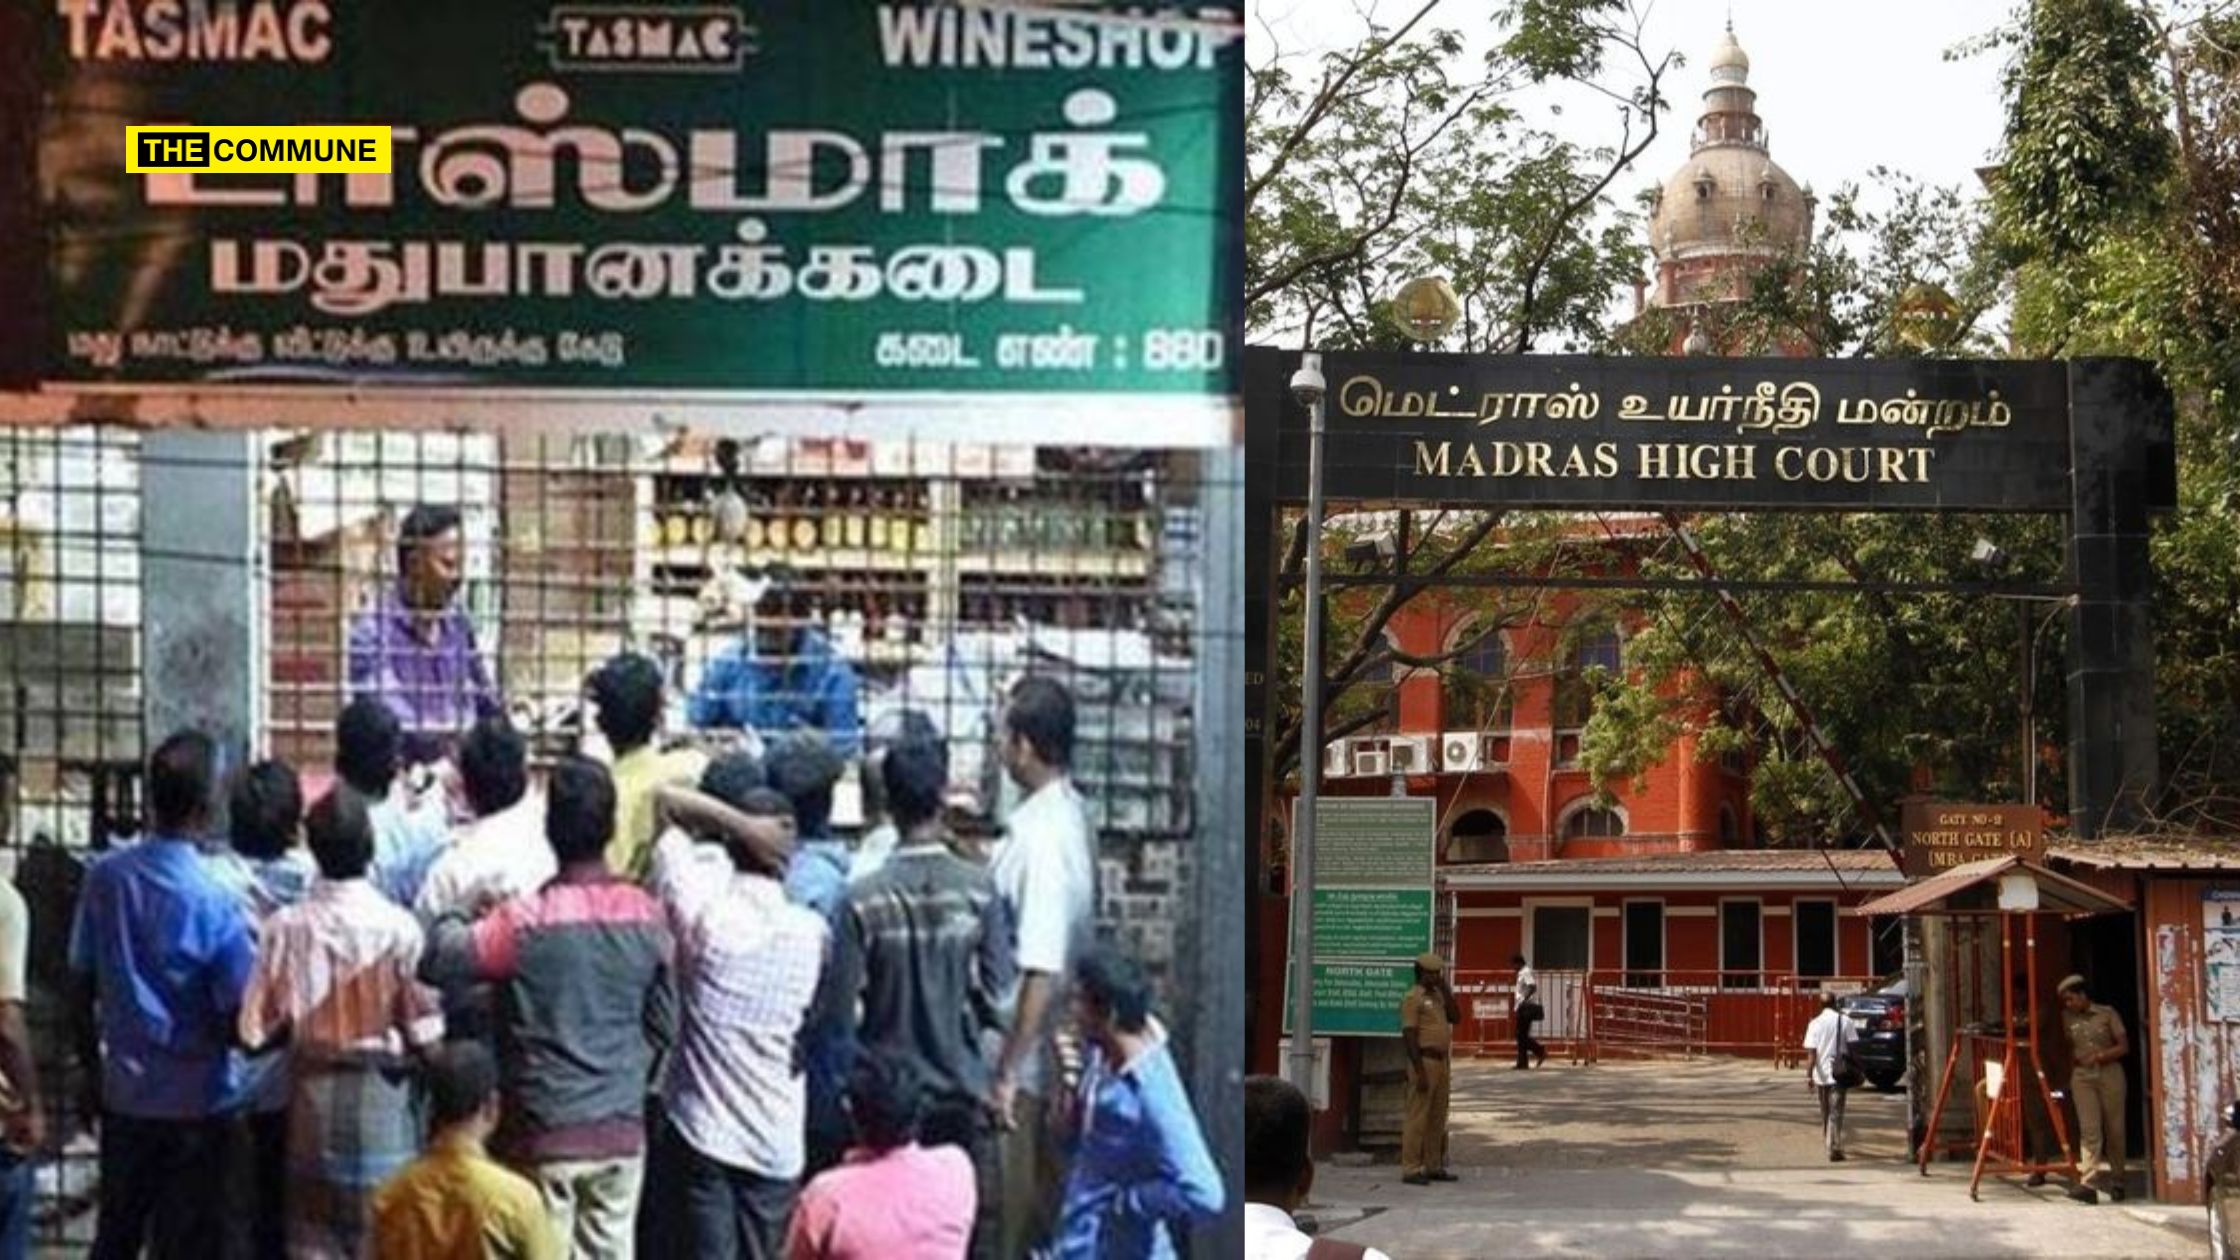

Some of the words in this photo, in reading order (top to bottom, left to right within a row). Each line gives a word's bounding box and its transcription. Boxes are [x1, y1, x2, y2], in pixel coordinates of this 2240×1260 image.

[58, 0, 332, 59] TASMAC
[562, 18, 731, 58] TASMAC
[878, 3, 1236, 68] WINESHOP
[211, 217, 1084, 315] மதுபானக்கடை
[876, 333, 980, 367] கடை
[996, 324, 1099, 369] எண்
[1114, 335, 1127, 369] :
[1340, 375, 1600, 426] மெட்ராஸ்
[1617, 381, 1821, 434] உயர்நீதி
[1836, 389, 2012, 438] மன்றம்
[1413, 441, 1618, 480] MADRAS
[1636, 443, 1758, 481] HIGH
[1774, 446, 1937, 483] COURT
[1911, 831, 1960, 847] NORTH
[1965, 831, 2001, 847] GATE
[1326, 966, 1363, 977] NORTH
[1366, 966, 1394, 978] GATE
